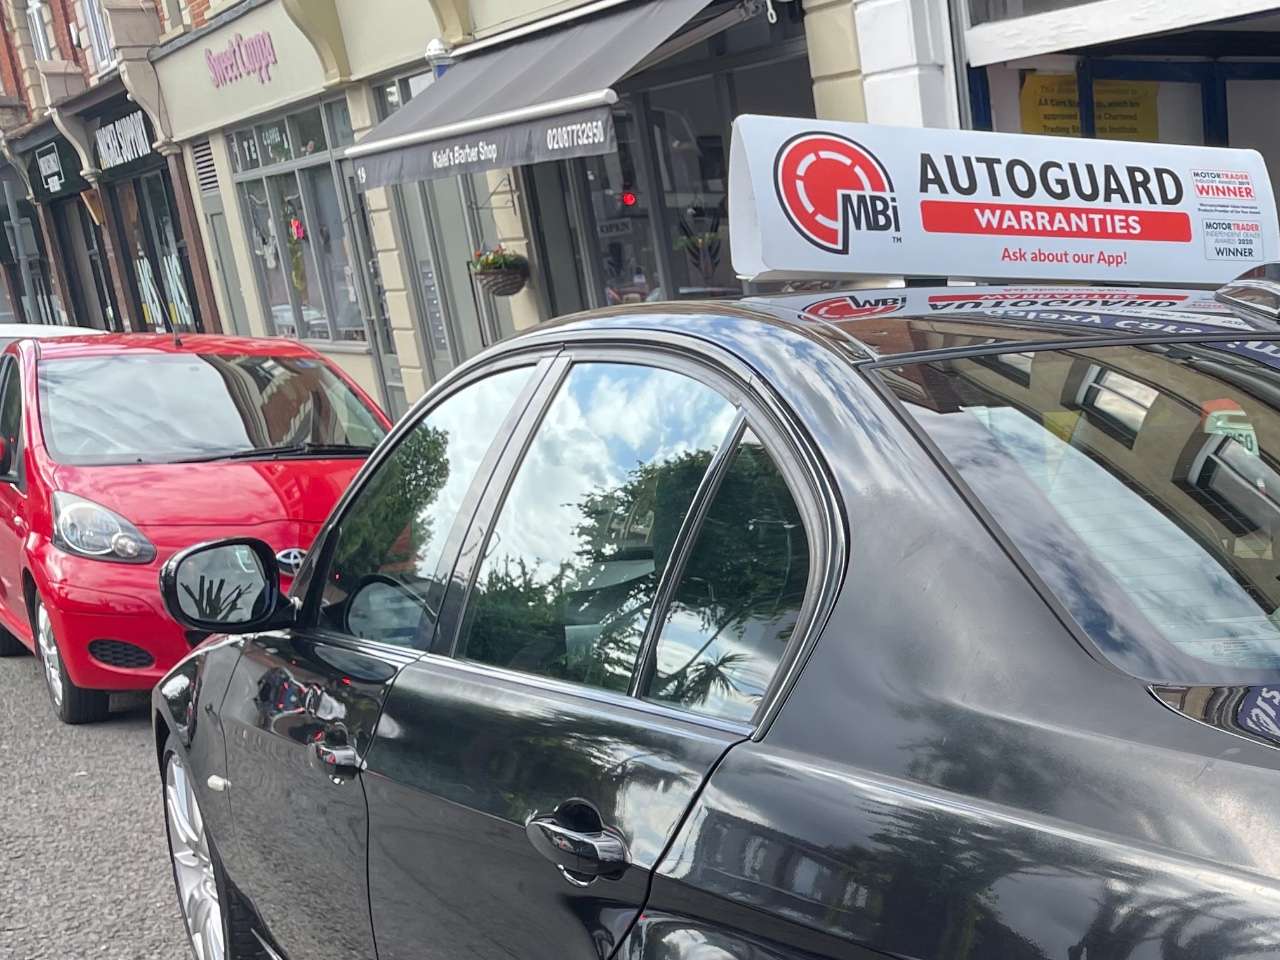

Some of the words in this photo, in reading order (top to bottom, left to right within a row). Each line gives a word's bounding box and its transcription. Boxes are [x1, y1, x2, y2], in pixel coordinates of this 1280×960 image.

[453, 144, 479, 165] Barber
[478, 140, 498, 163] Shop
[919, 152, 1184, 206] AUTOGUARD
[1195, 184, 1253, 198] WINNER
[973, 207, 1142, 235] WARRANTIES
[1001, 247, 1027, 263] Ask
[1030, 248, 1069, 264] about
[1072, 253, 1094, 265] our
[1096, 250, 1128, 267] App!
[1214, 246, 1254, 258] WINNER
